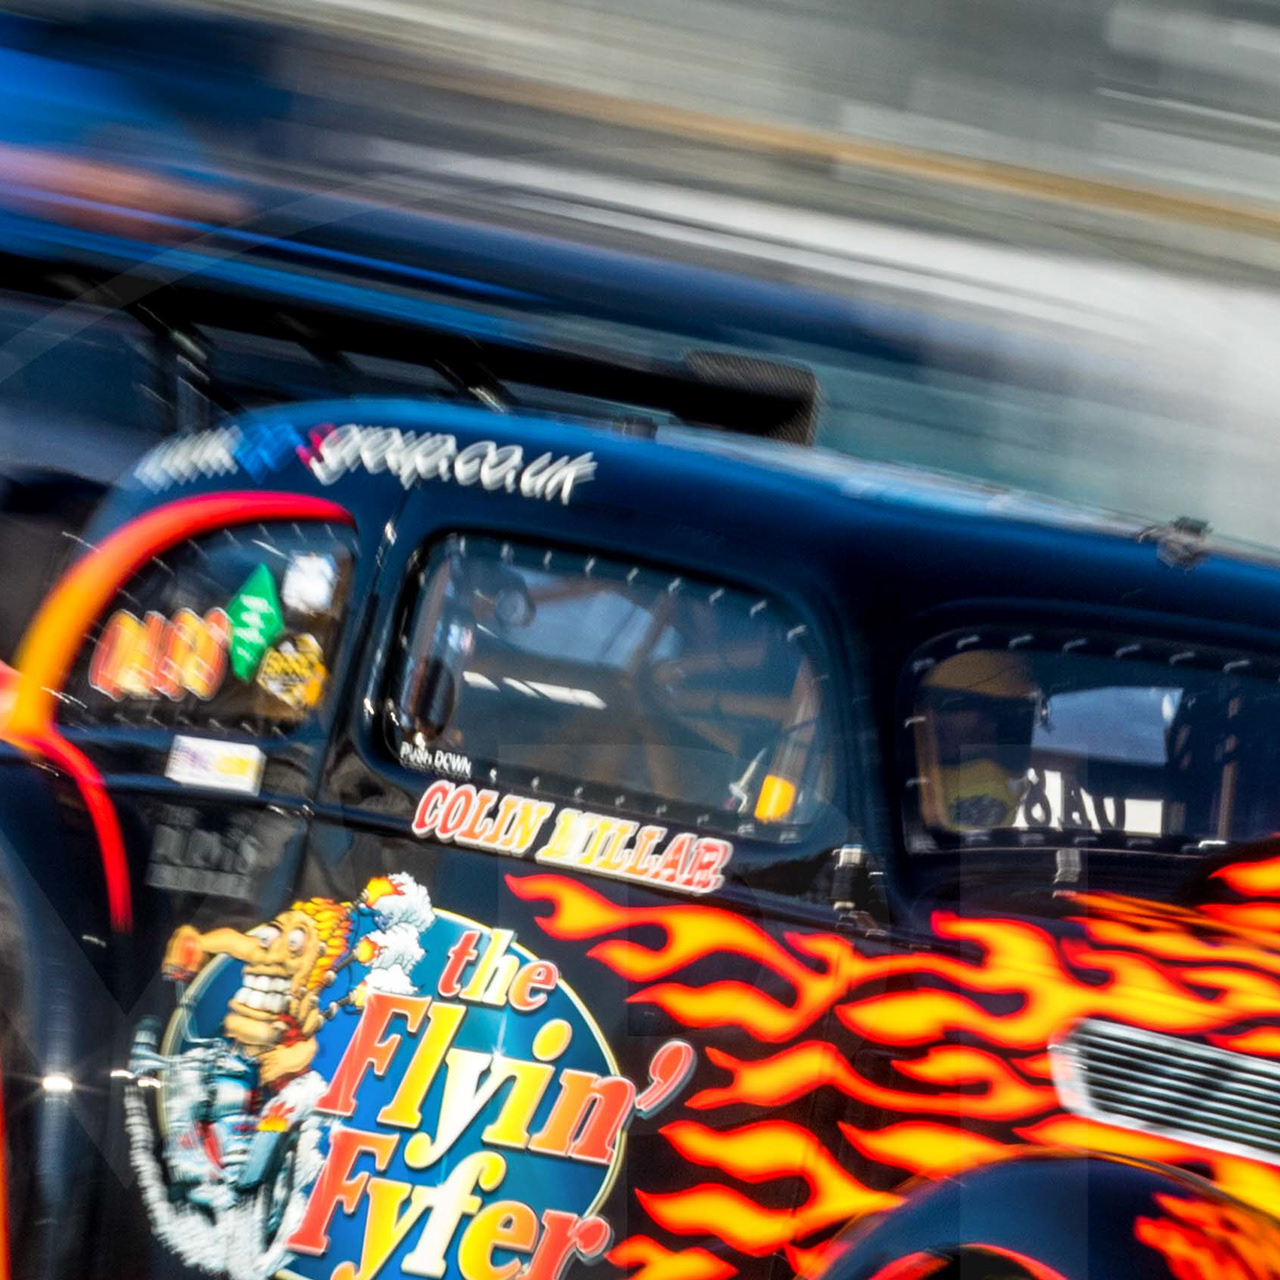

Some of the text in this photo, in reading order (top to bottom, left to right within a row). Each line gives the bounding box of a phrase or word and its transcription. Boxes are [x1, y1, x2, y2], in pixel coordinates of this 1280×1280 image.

[434, 750, 472, 778] DOWN
[412, 779, 733, 894] COLIN MILLAR
[438, 929, 559, 1011] the
[316, 991, 696, 1169] Flyin'
